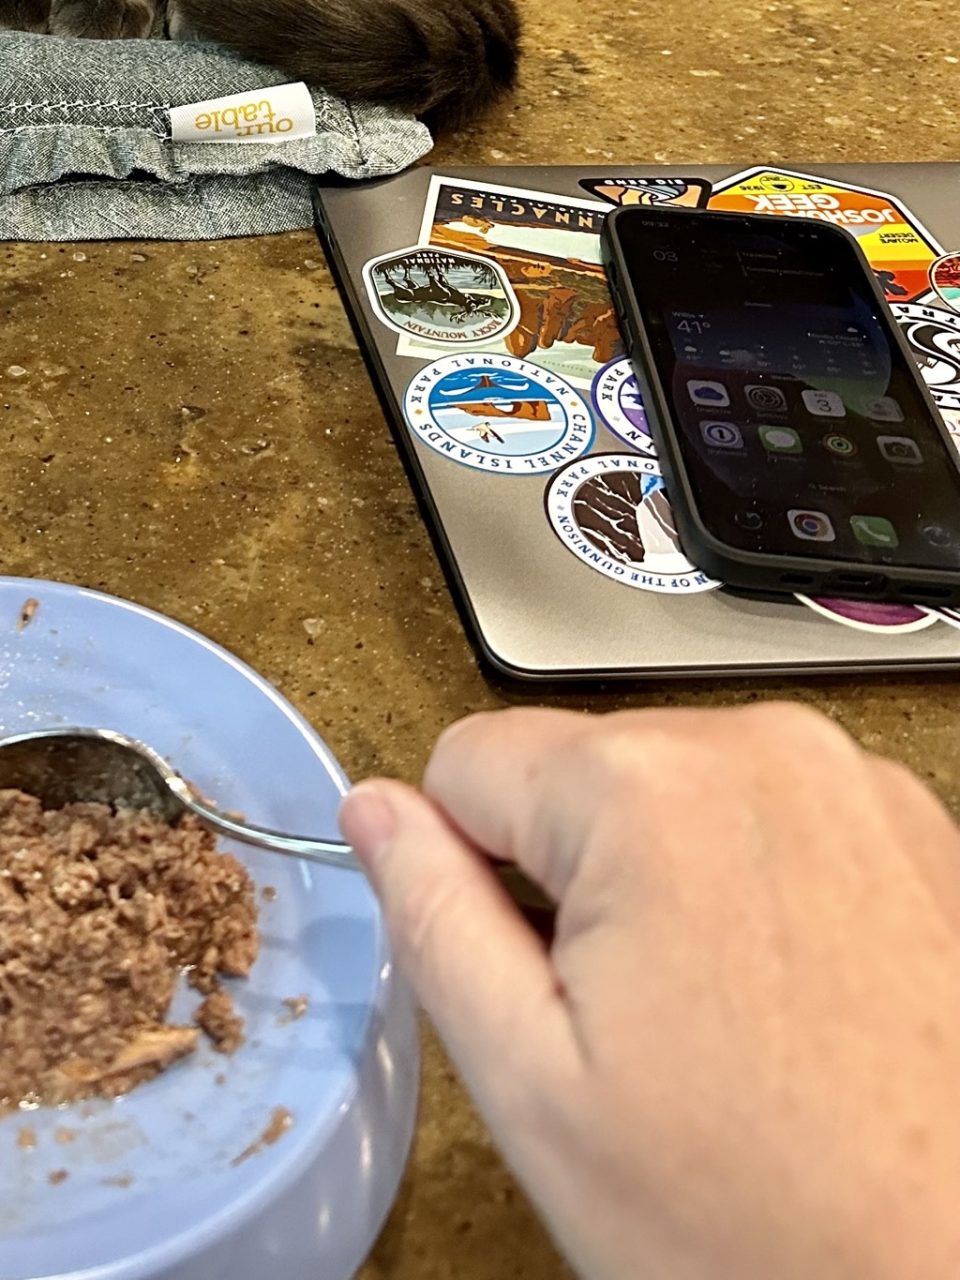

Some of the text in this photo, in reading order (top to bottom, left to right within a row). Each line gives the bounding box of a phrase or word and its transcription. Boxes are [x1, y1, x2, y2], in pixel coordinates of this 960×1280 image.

[194, 100, 276, 132] table
[236, 118, 294, 137] our
[451, 193, 593, 229] NNACLES
[744, 194, 840, 211] GEEK
[404, 319, 502, 339] ROCKY MOUNTAIN
[676, 319, 712, 335] 41°
[410, 357, 569, 404] NATIONAL PARK
[603, 368, 625, 402] PARK
[419, 413, 587, 469] CHANNEL ISLANDS
[557, 459, 656, 498] ONAL PARK
[557, 513, 625, 576] GUNNISON
[630, 572, 666, 587] THE
[670, 574, 691, 588] OF
